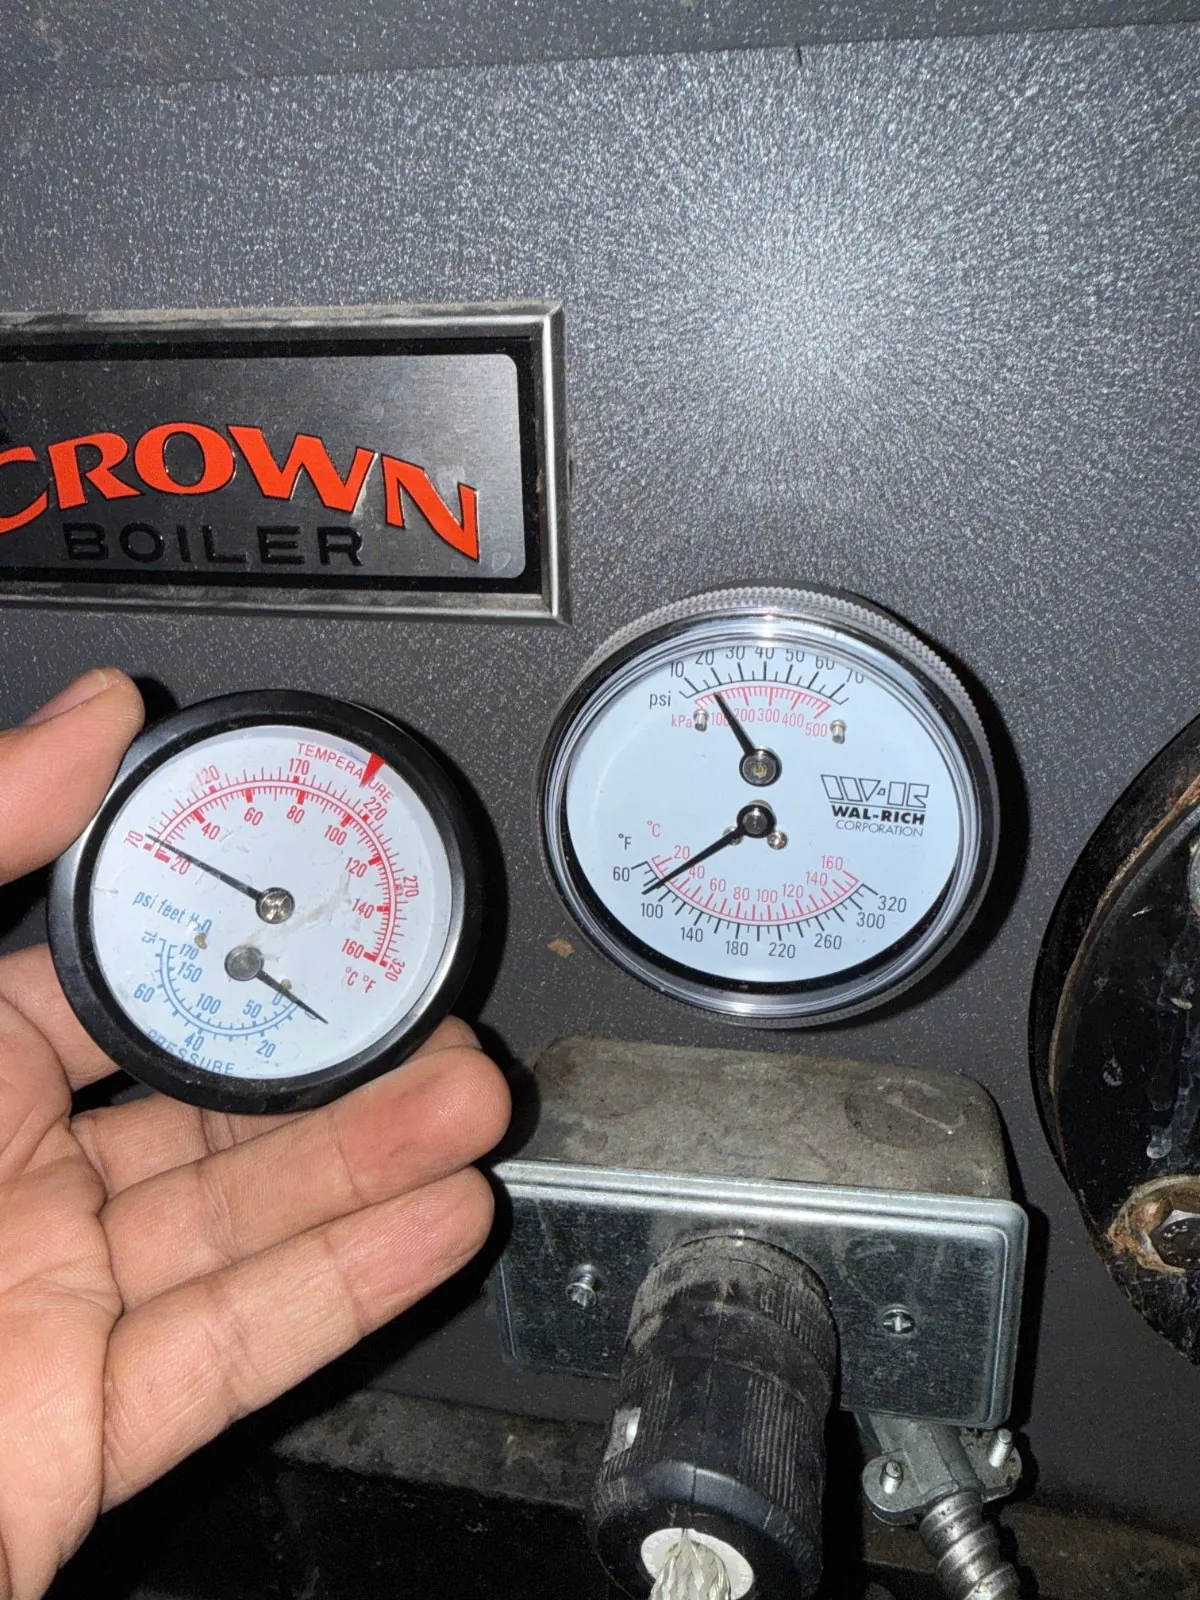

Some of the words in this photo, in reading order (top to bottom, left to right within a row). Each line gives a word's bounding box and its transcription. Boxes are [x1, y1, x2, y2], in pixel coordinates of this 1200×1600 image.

[62, 522, 364, 567] BOILER
[670, 660, 685, 678] 10
[725, 646, 745, 660] 30
[649, 690, 672, 710] psi
[671, 713, 693, 728] kPa
[757, 707, 780, 723] 300
[782, 712, 804, 728] 400
[805, 722, 828, 737] 500
[195, 765, 220, 786] 120
[289, 757, 311, 776] 170
[296, 742, 394, 804] TEMPERAURE
[243, 807, 264, 826] 60
[286, 805, 305, 824] 80
[362, 796, 388, 821] 220
[831, 804, 925, 825] WAL-RICH
[201, 822, 221, 841] 40
[323, 824, 348, 846] 100
[836, 819, 924, 837] CORPORATION
[169, 855, 191, 875] 20
[345, 857, 368, 878] 120
[673, 845, 690, 860] 20
[688, 865, 706, 880] 40
[709, 877, 726, 893] 60
[733, 886, 750, 901] 80
[756, 888, 778, 904] 100
[782, 883, 804, 899] 120
[805, 871, 828, 887] 140
[821, 855, 844, 871] 160
[402, 875, 420, 898] 270
[132, 891, 159, 909] psi
[157, 899, 186, 924] feet
[351, 898, 375, 920] 140
[612, 866, 631, 882] 60
[640, 902, 664, 919] 100
[680, 926, 704, 943] 140
[725, 940, 749, 957] 180
[768, 942, 796, 959] 220
[814, 932, 842, 950] 260
[856, 911, 886, 930] 300
[877, 895, 907, 913] 320
[179, 943, 200, 961] 170
[341, 938, 365, 959] 160
[177, 961, 203, 983] 150
[384, 957, 406, 982] 320
[196, 992, 222, 1015] 100
[242, 999, 263, 1019] 50
[133, 983, 155, 1003] 60
[184, 1032, 205, 1052] 40
[256, 1039, 277, 1058] 20
